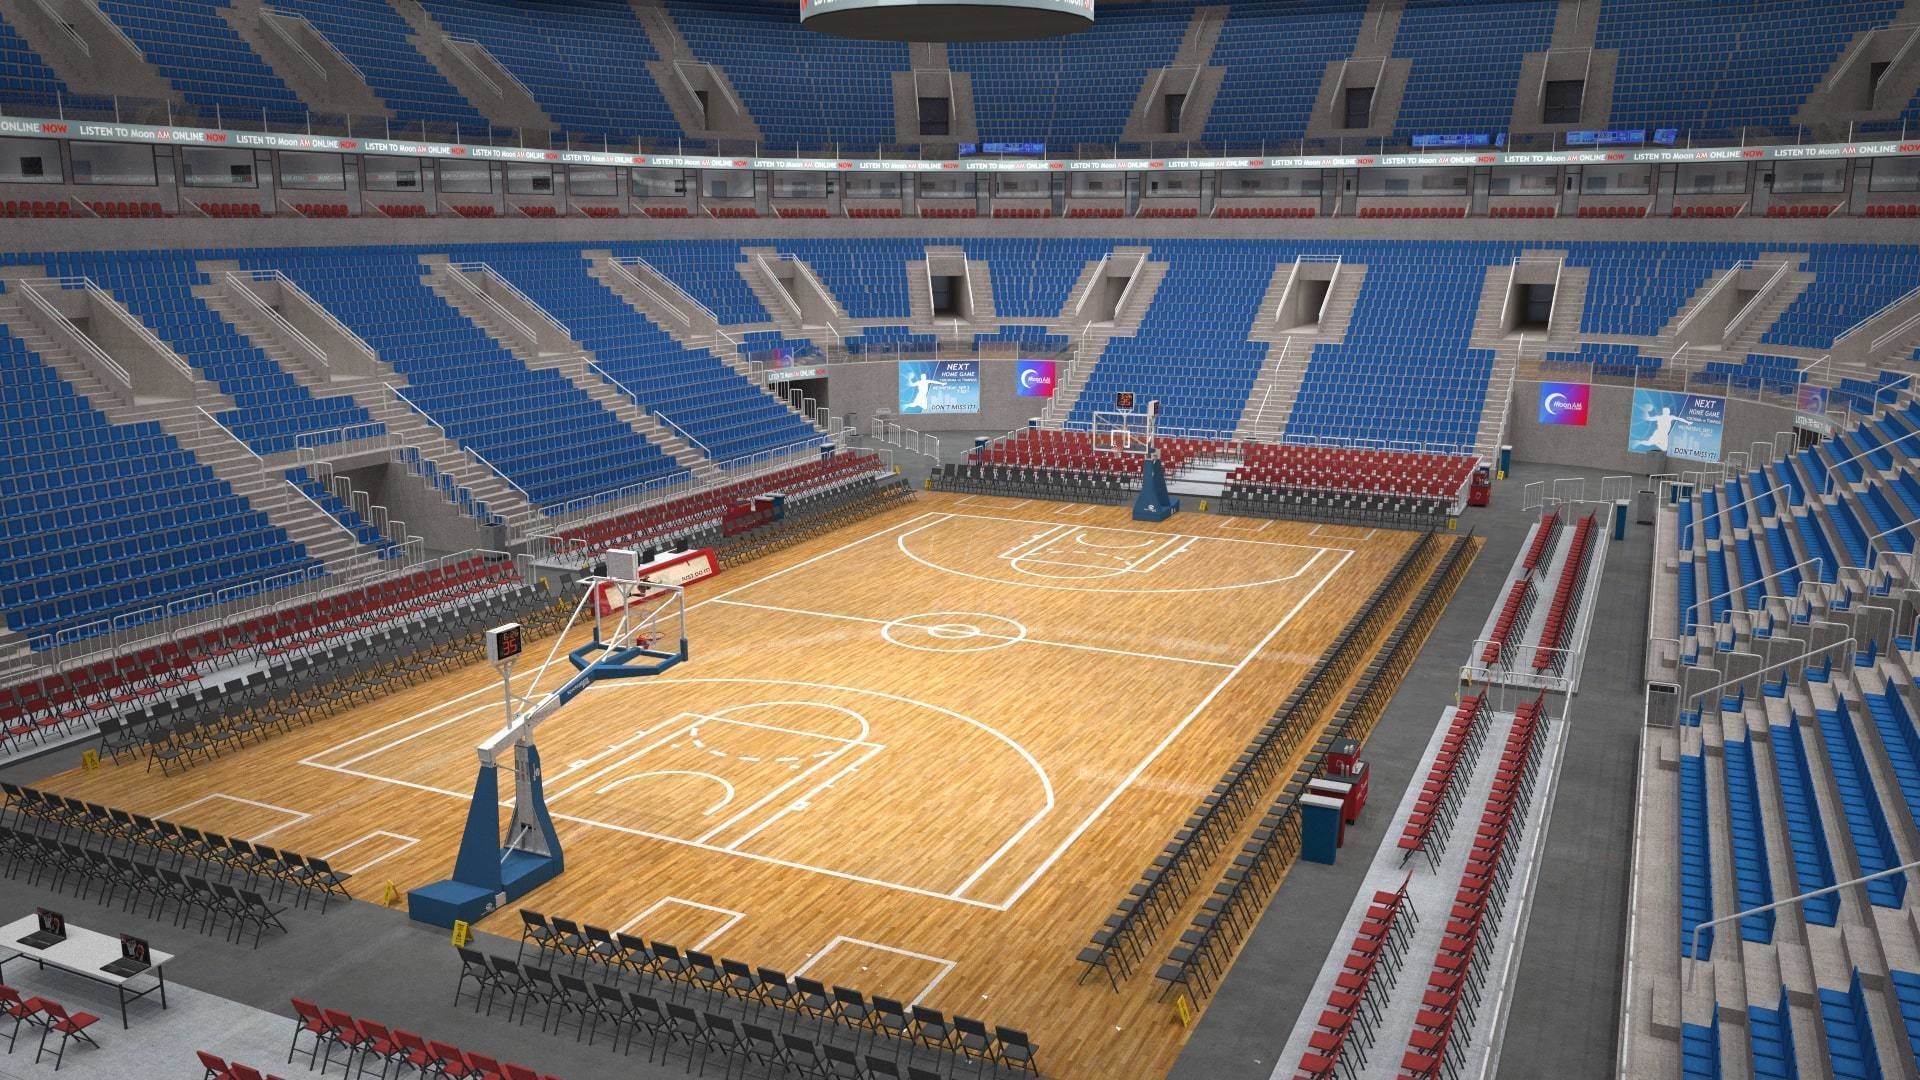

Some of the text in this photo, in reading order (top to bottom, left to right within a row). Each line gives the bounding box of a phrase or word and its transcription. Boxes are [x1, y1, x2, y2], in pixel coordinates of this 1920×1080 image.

[1, 121, 67, 134] ONLINE NOW
[80, 125, 226, 142] LISTEN TO Moon AM ONLINE NOW
[237, 135, 357, 149] LISTEN TO Moon AM ONLINE NOW
[365, 142, 388, 151] LISTEN
[473, 148, 491, 157] LISTEN
[493, 149, 500, 157] TO
[1633, 153, 1659, 161] LISTEN
[1661, 152, 1671, 160] TO
[1672, 152, 1694, 160] Moon
[1709, 150, 1741, 159] ONLINE
[1743, 150, 1764, 158] NOW
[1774, 148, 1803, 157] LISTEN
[1805, 148, 1817, 156] TO
[1818, 147, 1839, 156] Moon
[1841, 146, 1856, 154] AM
[1859, 144, 1896, 154] ONLINE
[563, 153, 581, 161] LISTEN
[583, 154, 590, 162] TO
[652, 157, 673, 165] LISTEN
[1504, 155, 1529, 163] LISTEN
[1607, 153, 1625, 161] NOW
[946, 363, 970, 371] NEXT
[1694, 398, 1717, 409] NEXT
[1688, 408, 1721, 418] HOME GAME
[1673, 447, 1693, 456] DON'T
